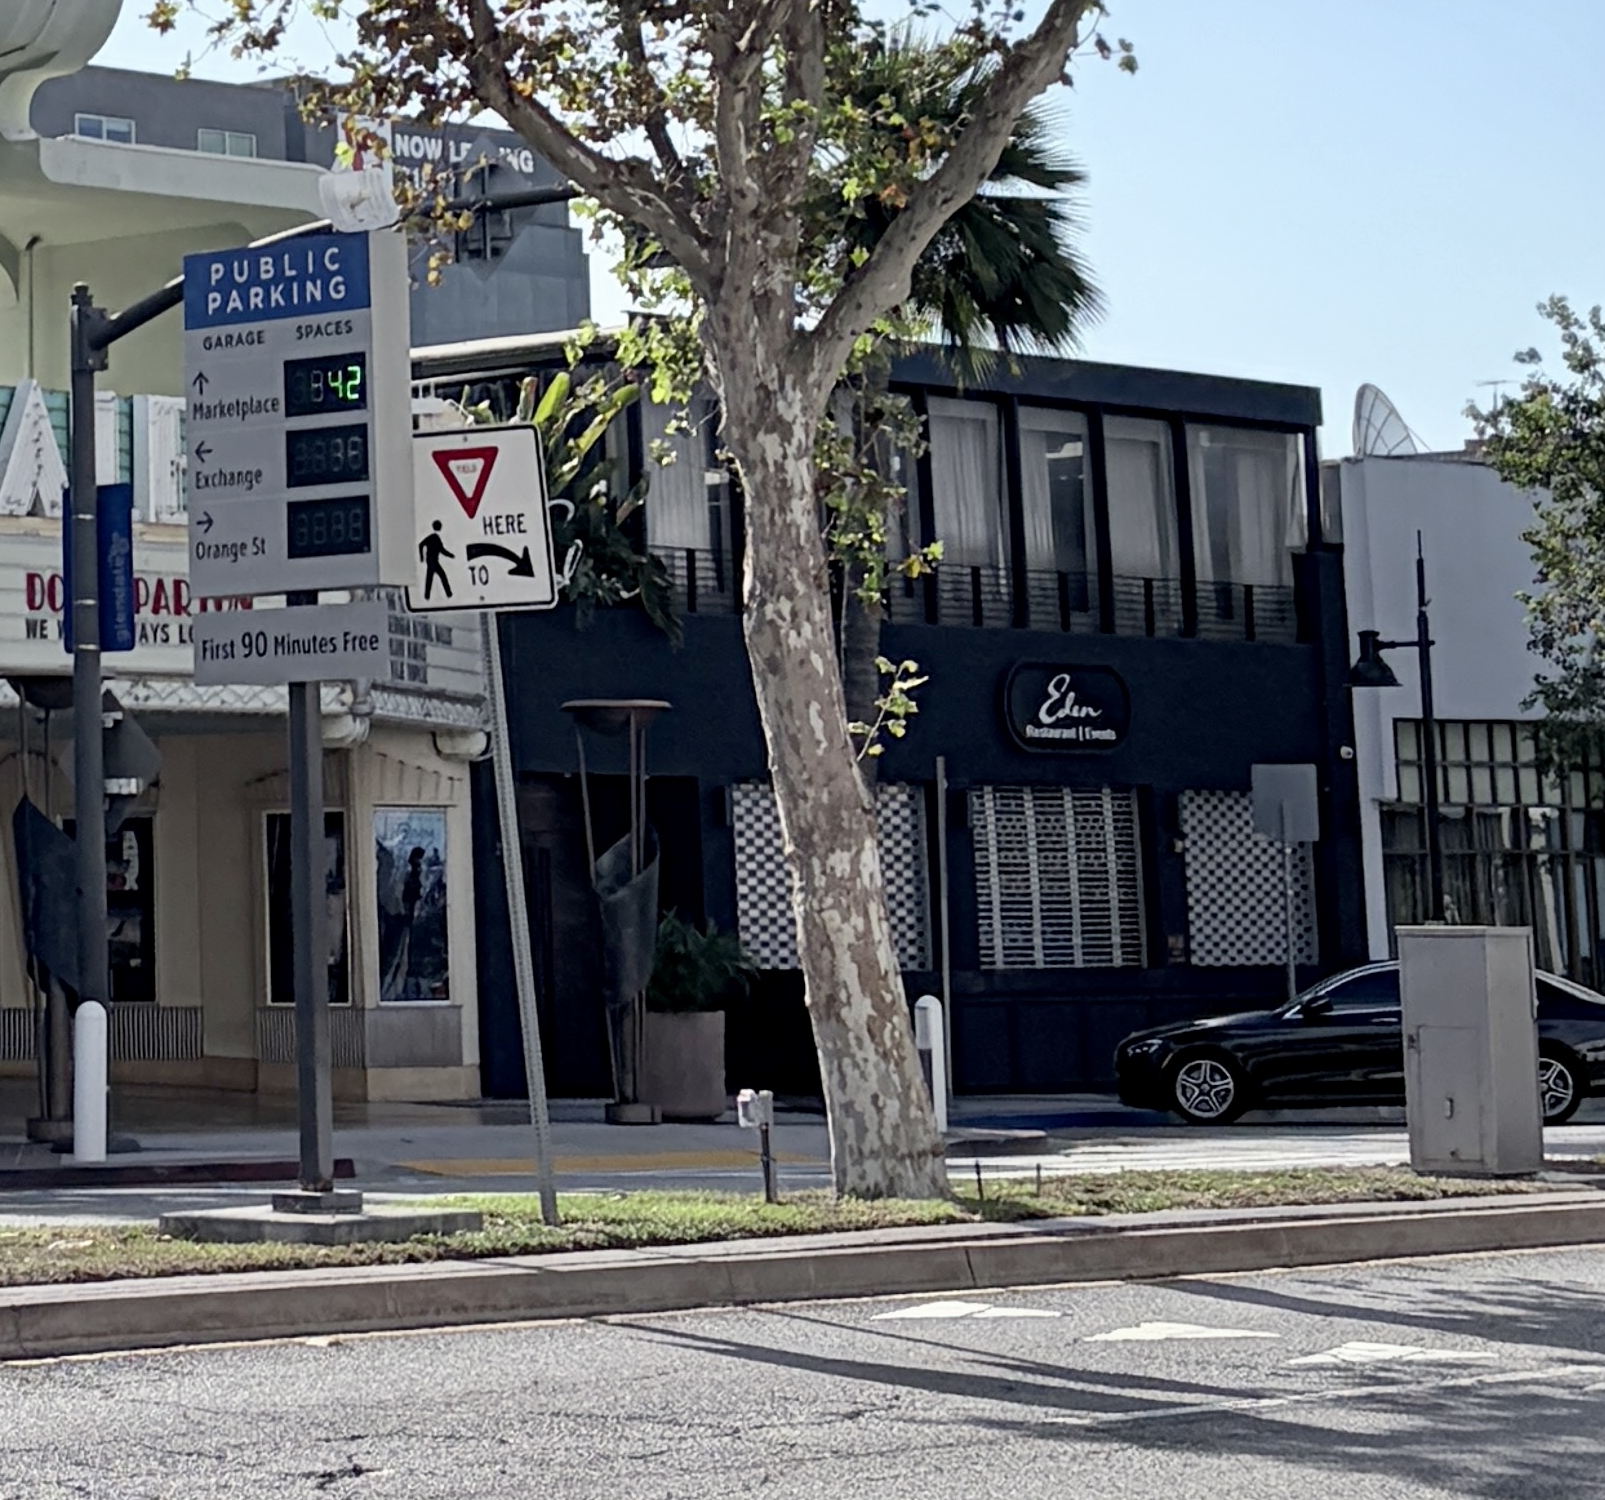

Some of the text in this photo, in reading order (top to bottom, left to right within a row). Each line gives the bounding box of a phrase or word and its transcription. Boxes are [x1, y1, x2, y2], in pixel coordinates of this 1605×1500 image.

[395, 133, 443, 161] NOW
[210, 247, 341, 286] PUBLIC
[208, 276, 346, 315] PARKING
[203, 320, 353, 351] GARAGE SPACES
[327, 365, 362, 400] 42
[192, 396, 280, 421] Marketplace
[196, 468, 262, 491] Exchange
[482, 513, 528, 536] HERE
[196, 536, 266, 563] Orange St
[468, 564, 489, 586] TO
[26, 620, 48, 639] WE
[202, 639, 235, 661] First
[241, 631, 268, 658] 90
[274, 633, 337, 656] Minutes
[343, 631, 380, 651] Free
[1038, 673, 1103, 725] Eden
